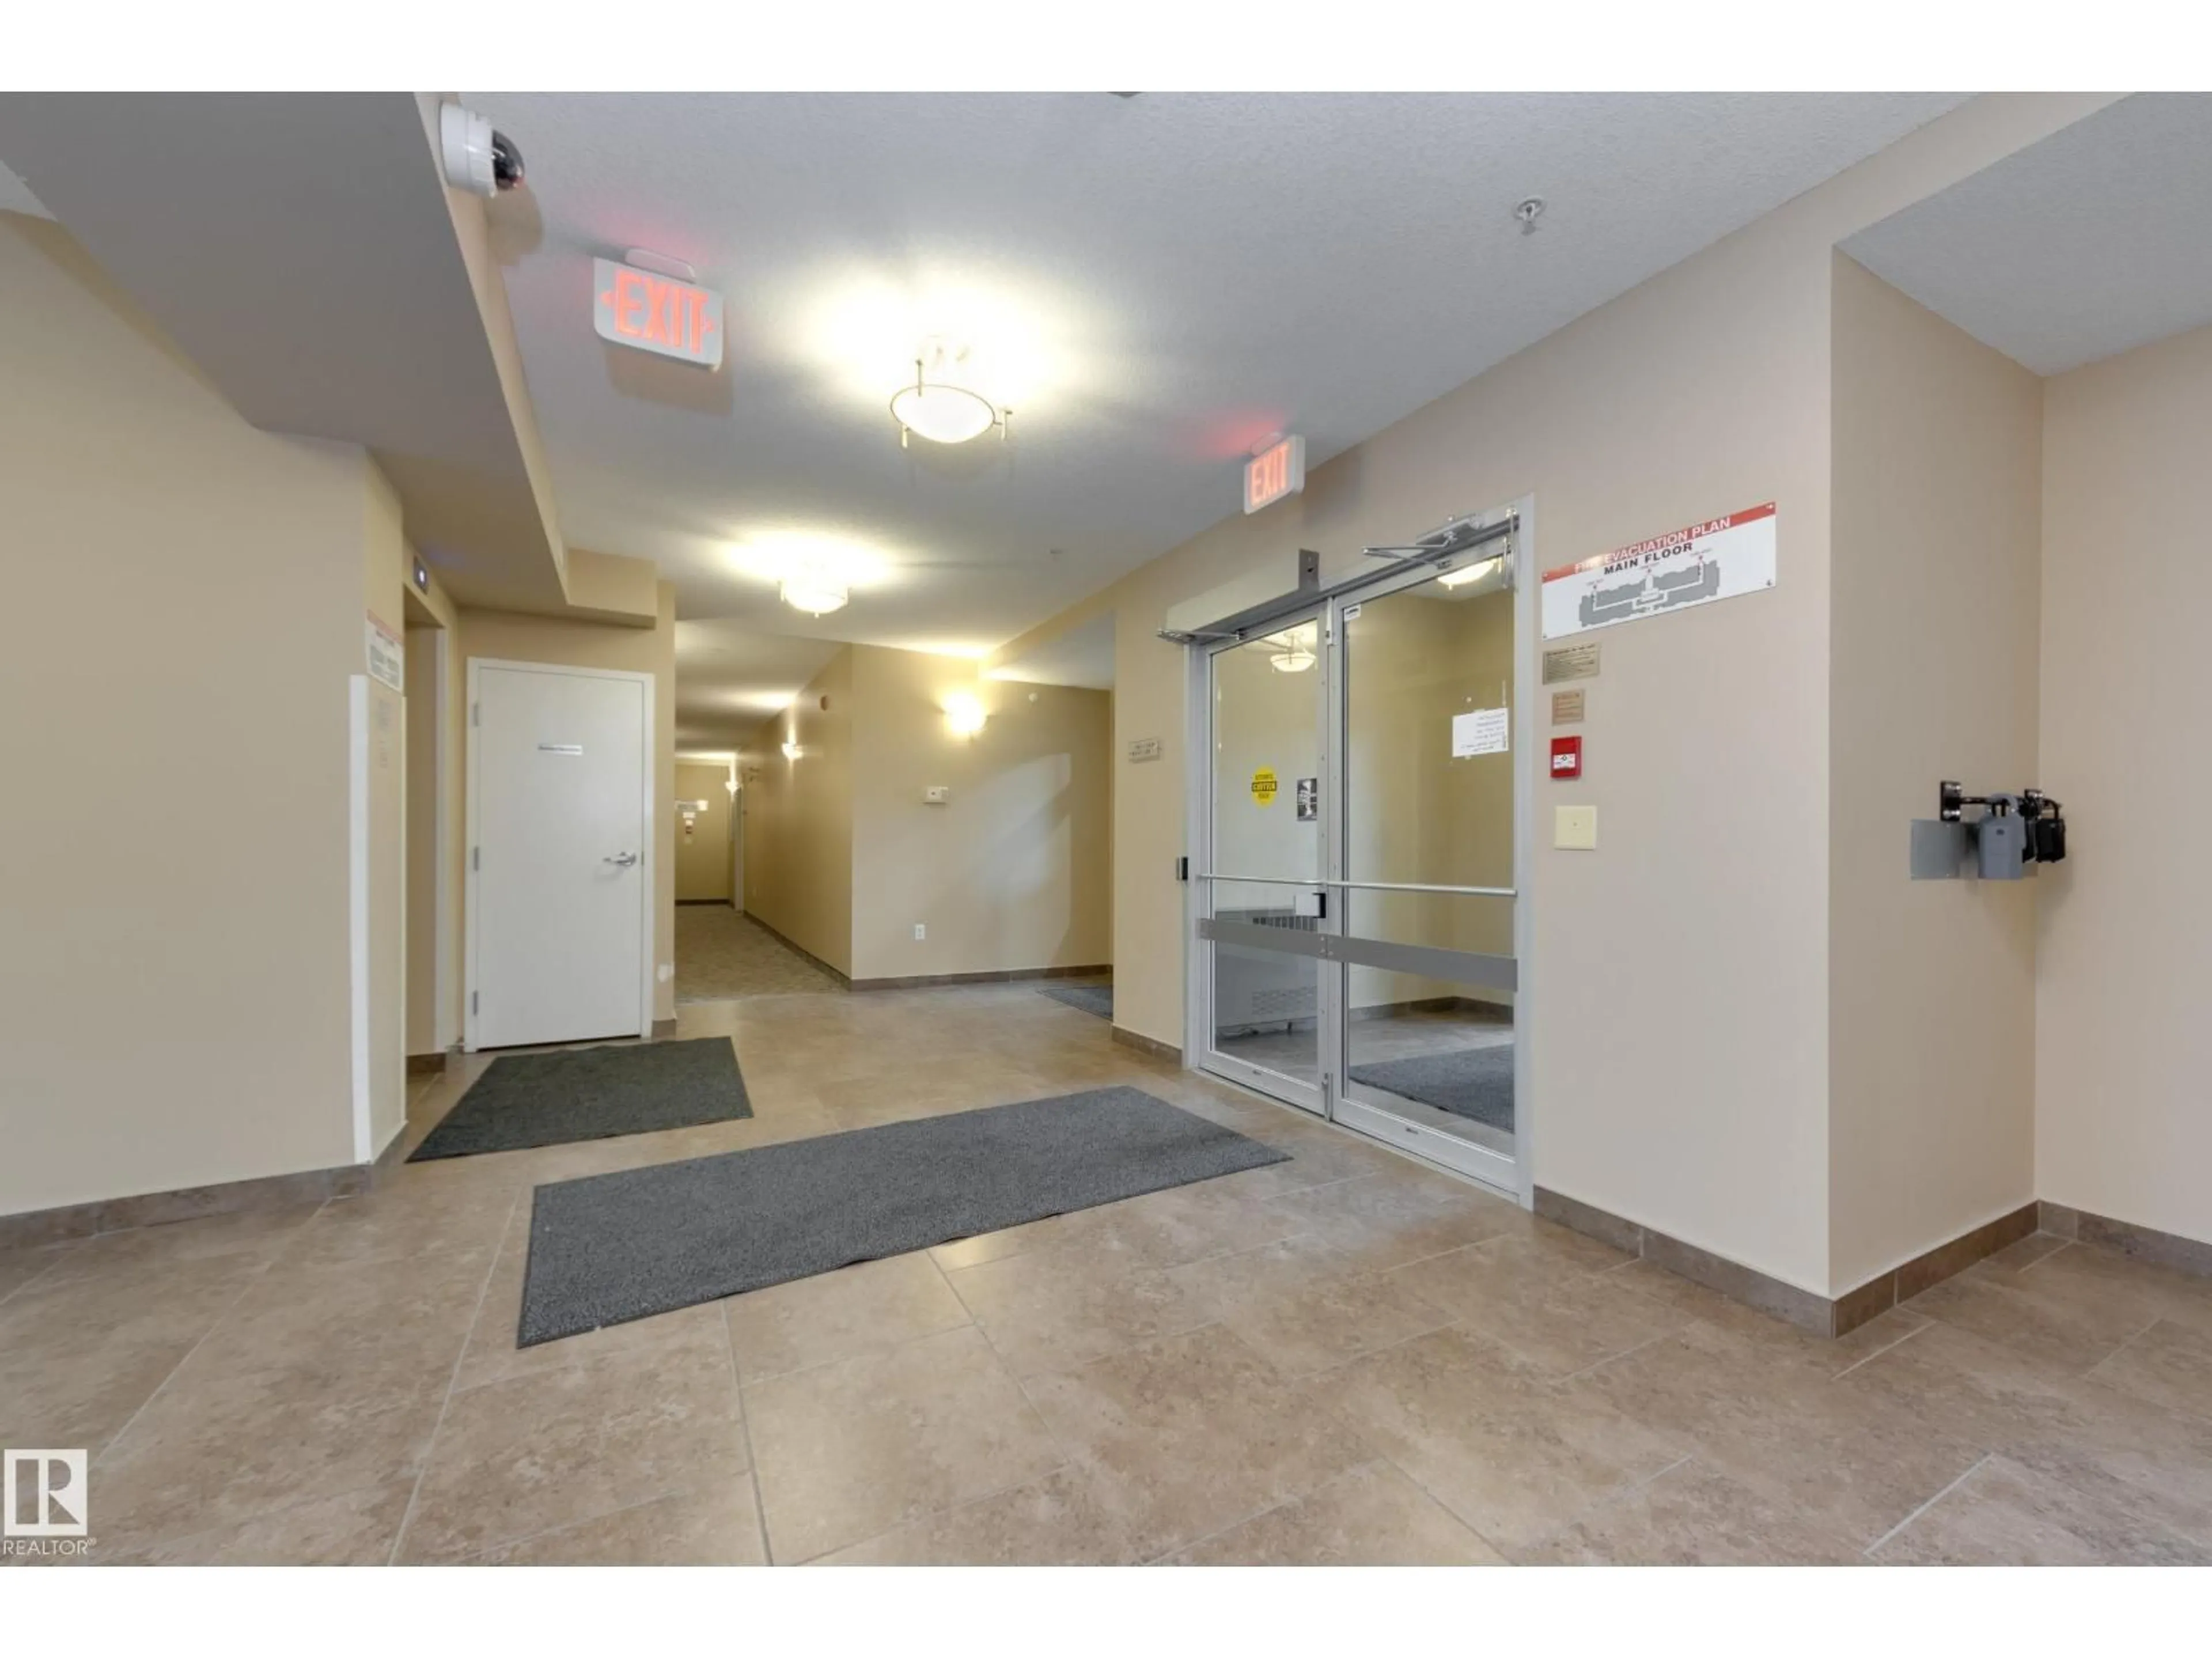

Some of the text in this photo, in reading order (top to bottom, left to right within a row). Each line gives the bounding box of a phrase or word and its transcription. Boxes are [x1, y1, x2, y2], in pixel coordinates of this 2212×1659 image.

[616, 270, 709, 354] EXIT
[1604, 558, 1638, 574] MAIN
[1645, 543, 1692, 563] FLOOR
[1605, 530, 1688, 563] EVACUATION
[1692, 517, 1730, 537] PLAN
